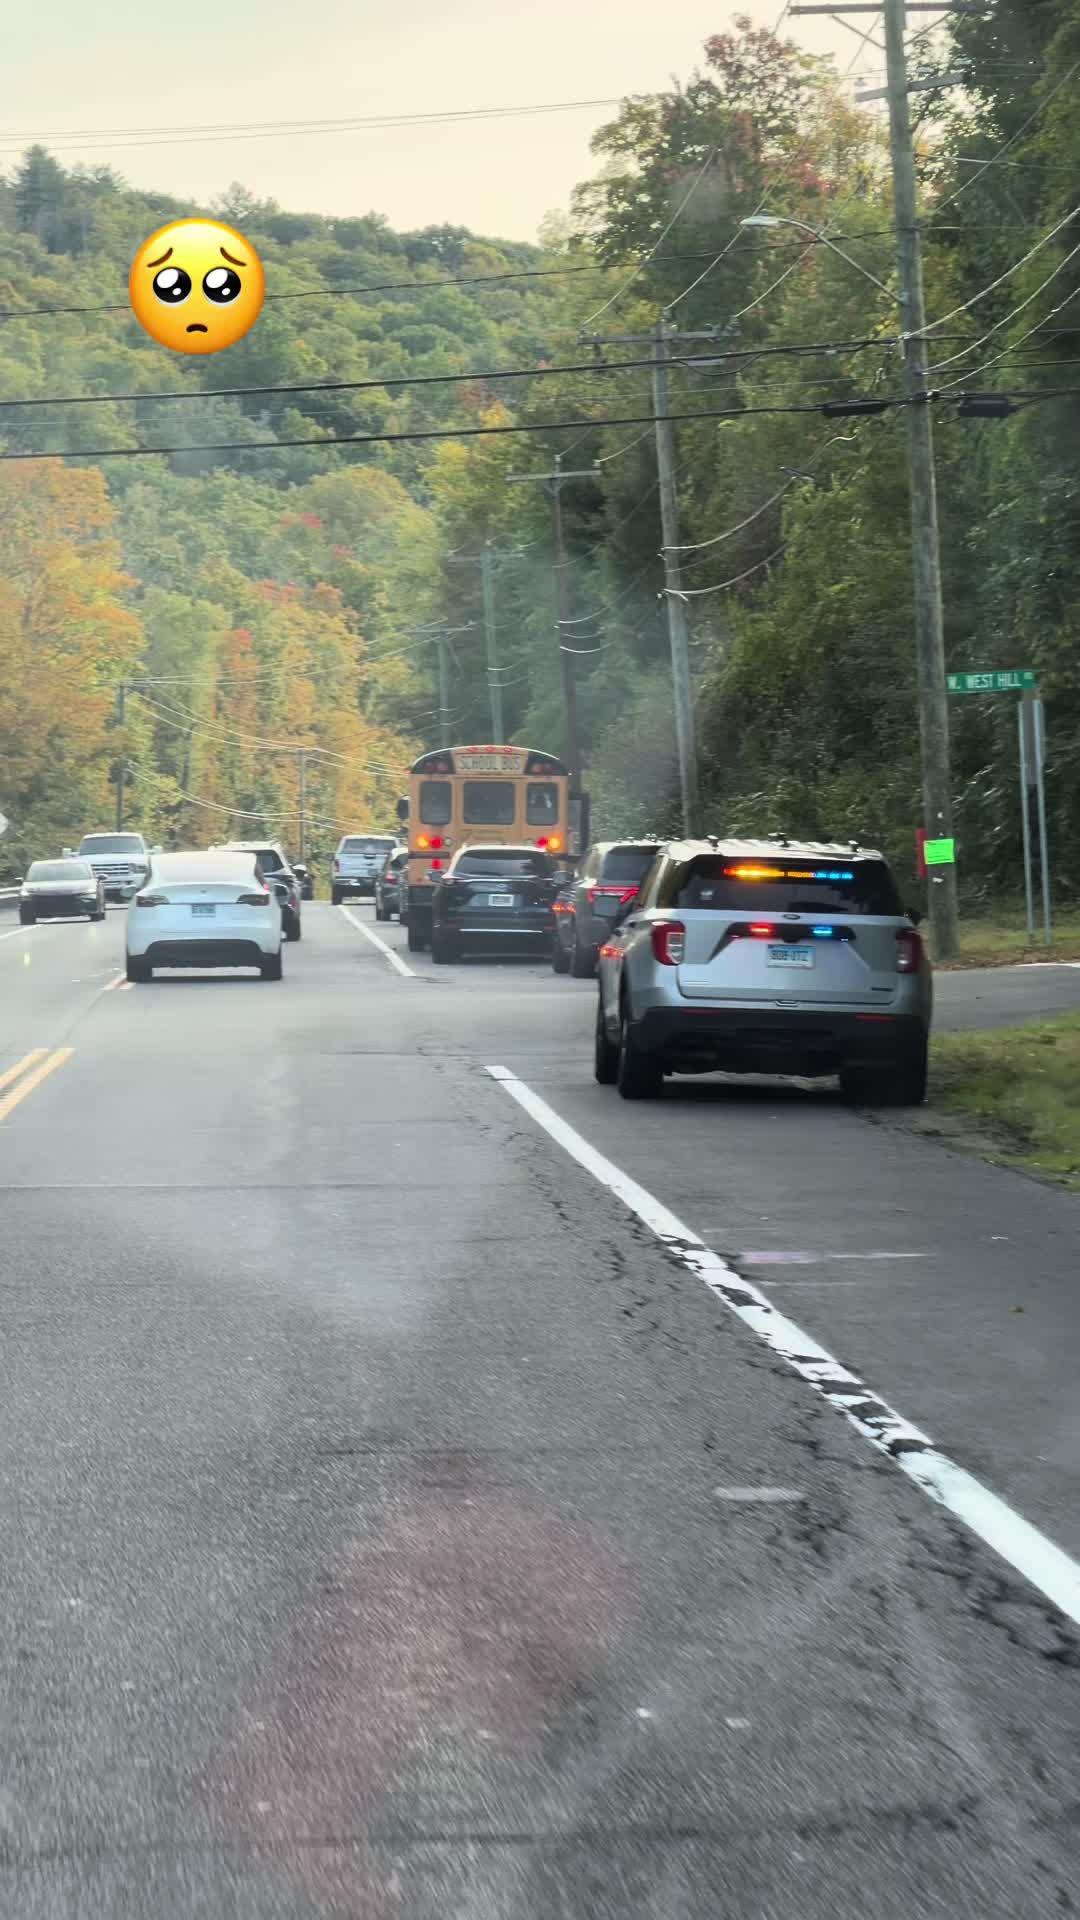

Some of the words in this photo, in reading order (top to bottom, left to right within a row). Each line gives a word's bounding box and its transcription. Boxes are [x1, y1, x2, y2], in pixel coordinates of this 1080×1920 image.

[965, 673, 993, 689] WEST
[997, 672, 1023, 687] HILL
[456, 755, 498, 770] SCHOOL
[501, 755, 521, 770] BUS
